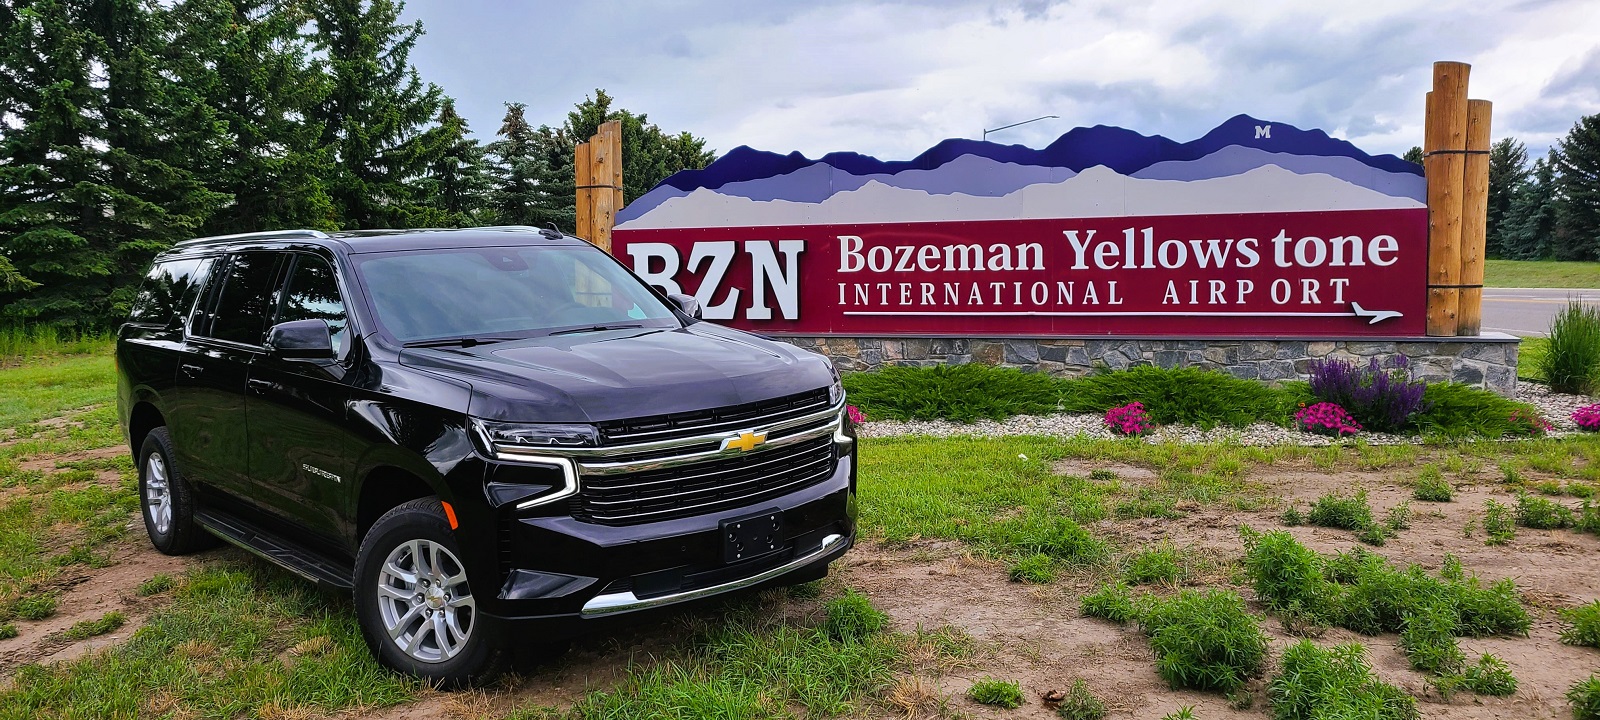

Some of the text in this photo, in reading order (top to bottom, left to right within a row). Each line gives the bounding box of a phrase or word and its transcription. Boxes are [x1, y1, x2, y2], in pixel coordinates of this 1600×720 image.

[1254, 125, 1271, 139] M
[836, 235, 1046, 273] Bozeman
[626, 239, 805, 321] BZN
[837, 278, 1350, 306] INTERNATIONAL AIRPORT
